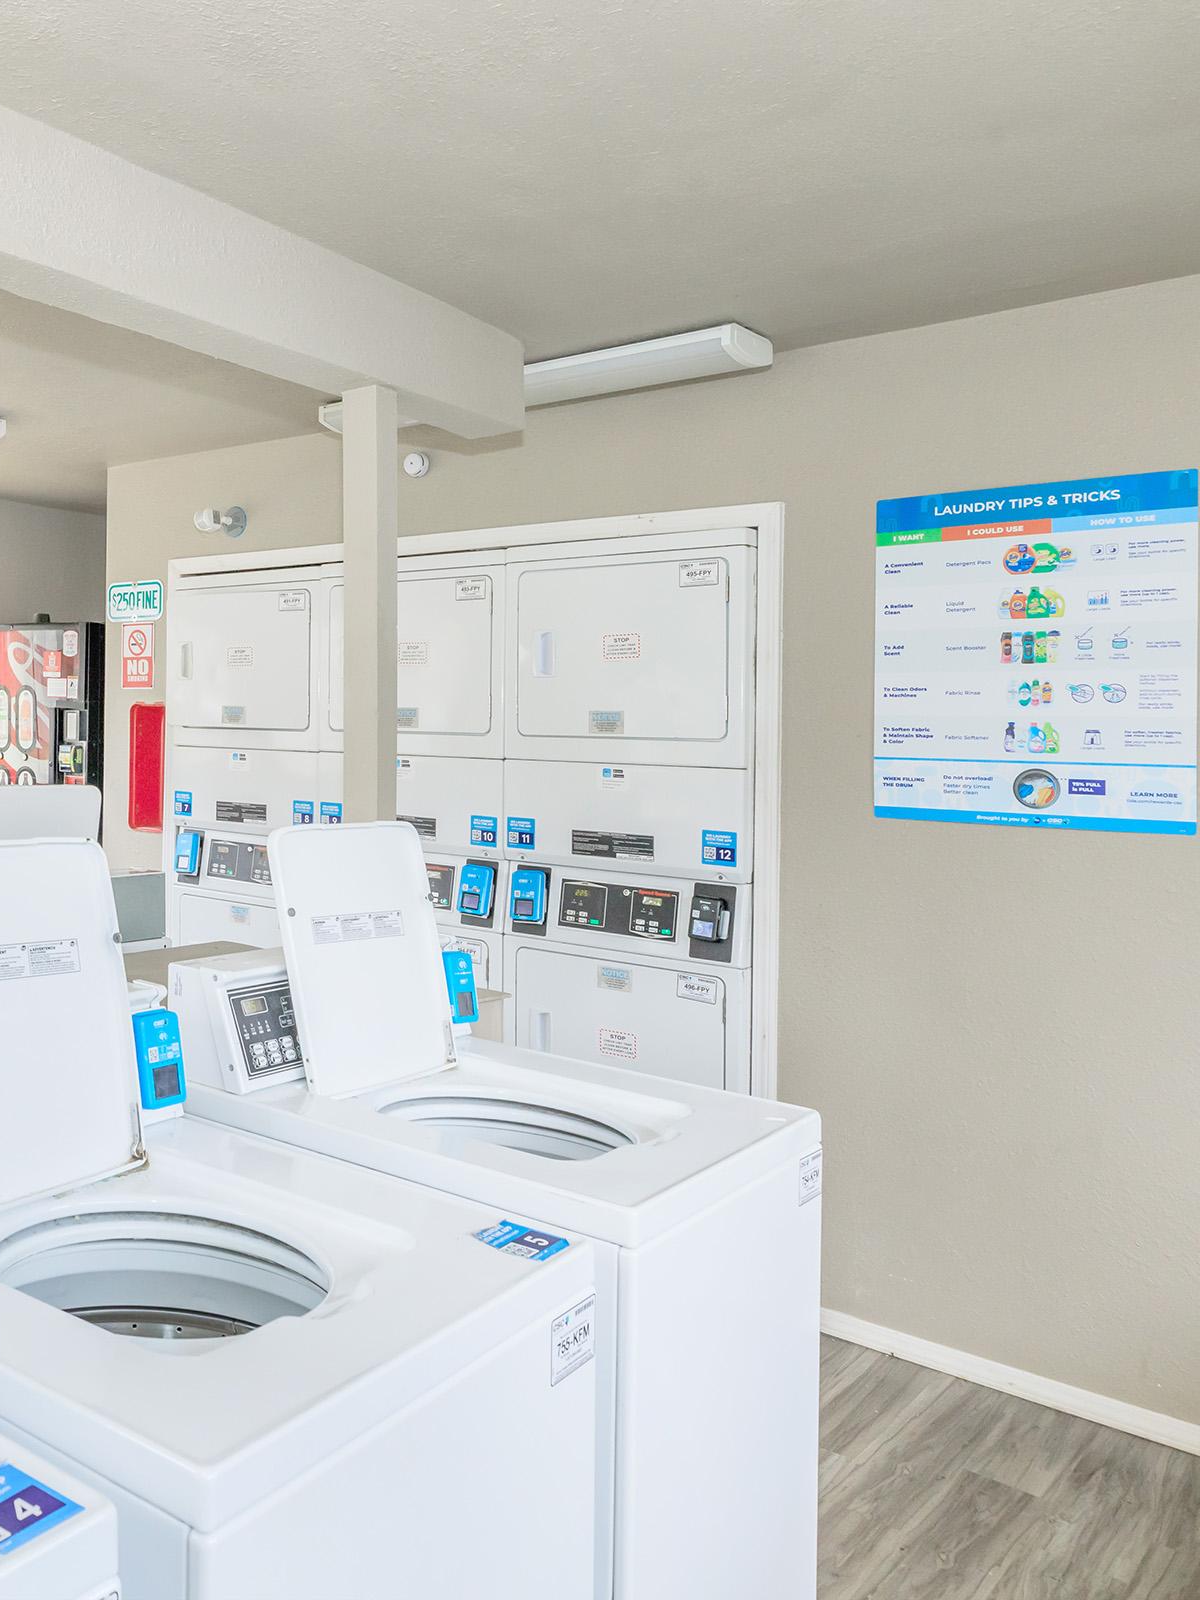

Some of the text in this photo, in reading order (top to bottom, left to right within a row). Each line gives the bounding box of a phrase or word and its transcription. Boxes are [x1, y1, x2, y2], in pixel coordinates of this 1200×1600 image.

[934, 489, 1121, 516] LAUNDRY TIPS & TRICKS
[1090, 518, 1116, 526] HOW
[1119, 516, 1133, 524] TO
[972, 526, 1004, 536] COULD
[1006, 525, 1025, 533] USE
[898, 533, 925, 542] WANT
[946, 560, 977, 568] Detergent
[112, 589, 158, 611] $250 FINE
[946, 606, 976, 614] Detergent
[127, 659, 149, 676] NO
[1130, 791, 1178, 799] LEARN MORE
[184, 804, 189, 812] 7
[304, 814, 310, 823] 8
[331, 816, 338, 824] 9
[976, 814, 1001, 822] Brought
[482, 832, 493, 842] 10
[521, 834, 530, 844] 11
[718, 849, 732, 860] 12
[523, 1234, 549, 1247] 5
[557, 1323, 590, 1358] 755-KFM
[12, 1497, 43, 1522] 4
